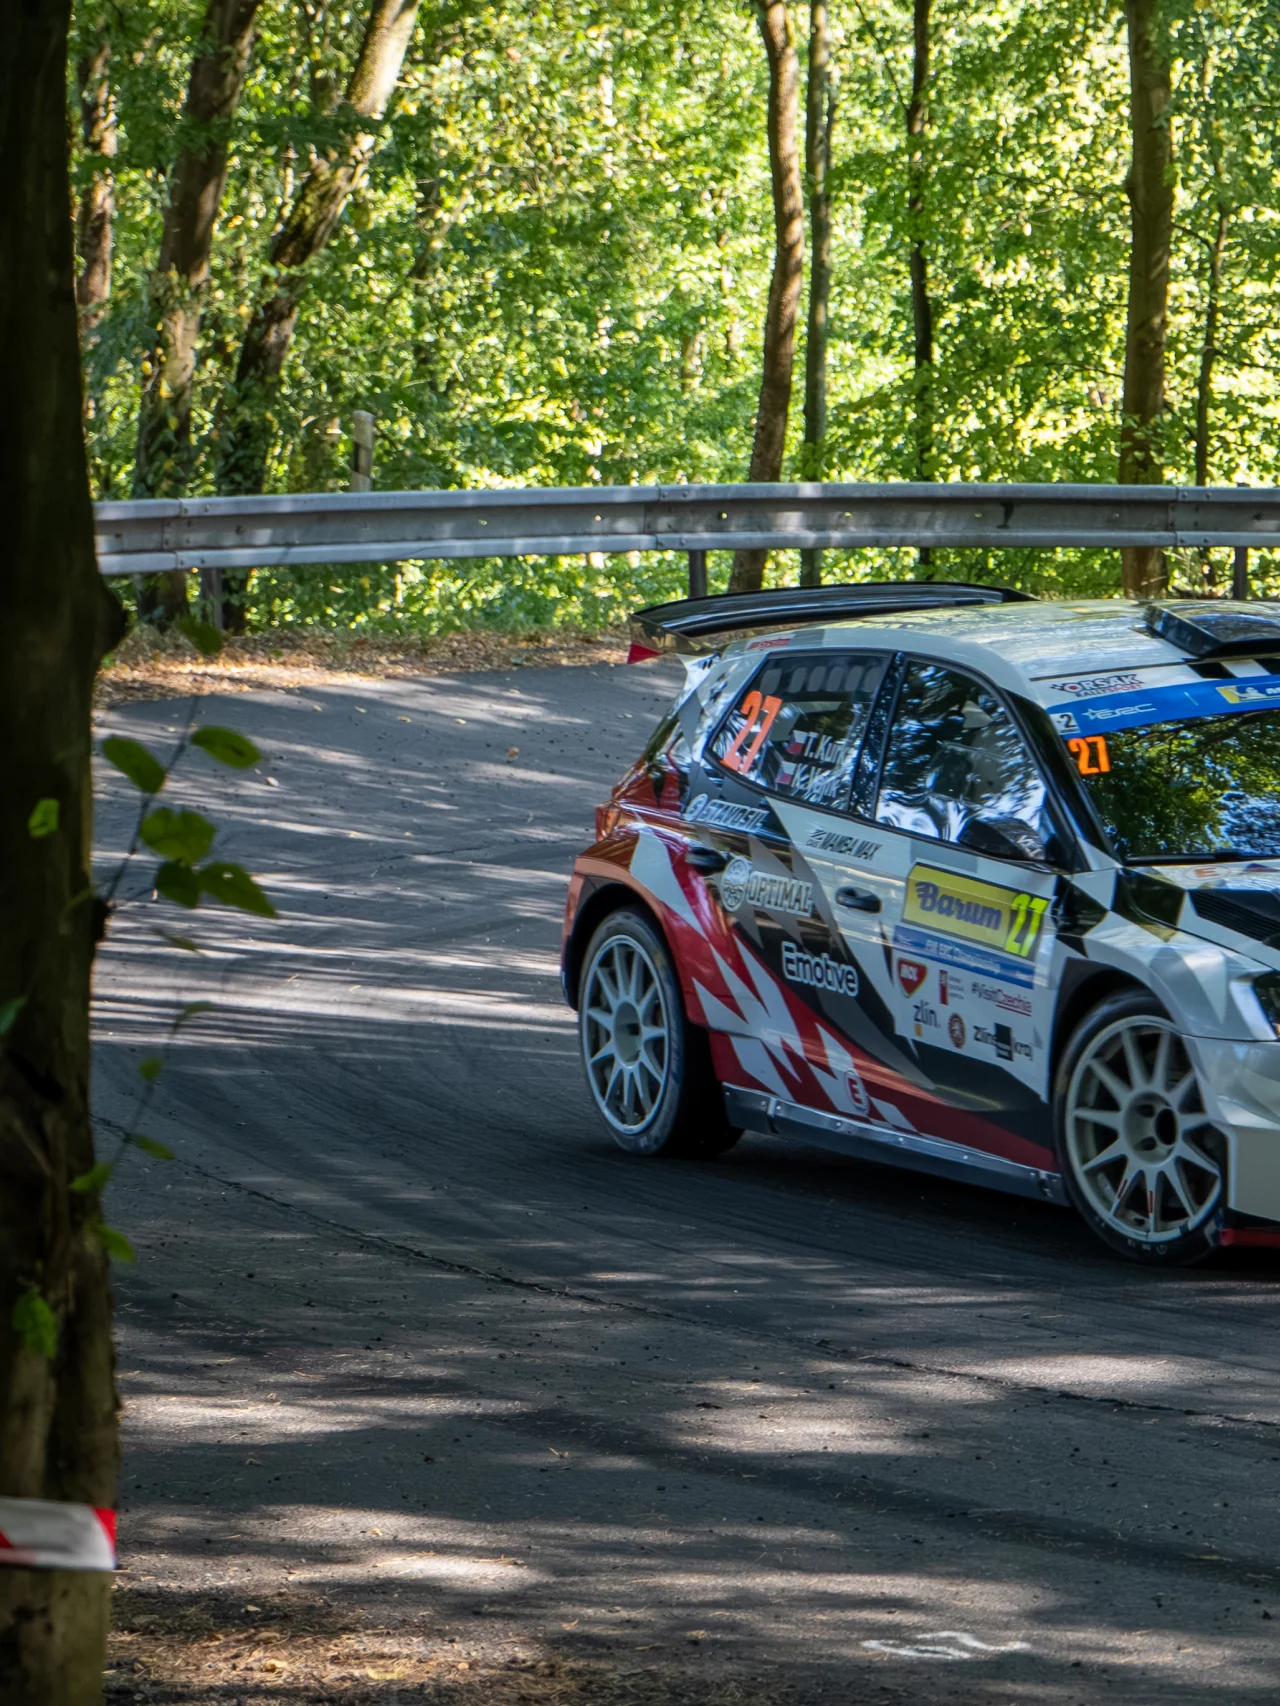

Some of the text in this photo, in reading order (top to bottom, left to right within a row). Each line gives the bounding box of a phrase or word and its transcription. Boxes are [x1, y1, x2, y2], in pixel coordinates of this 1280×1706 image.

[720, 690, 783, 774] 27
[1067, 735, 1111, 776] 27
[747, 873, 812, 915] OPTIMAL
[914, 880, 1050, 958] Barum 27
[782, 941, 858, 997] Emotive
